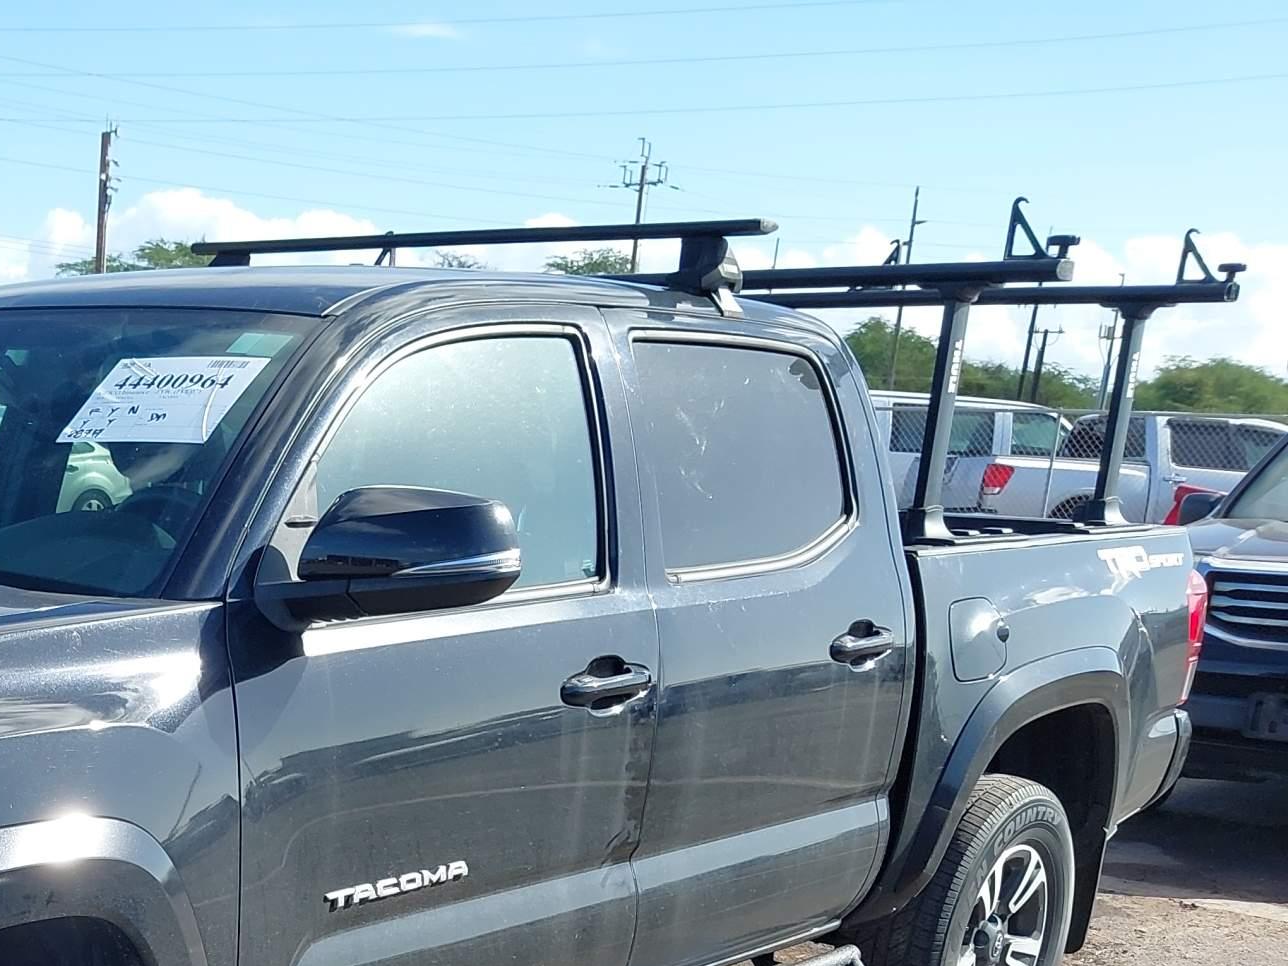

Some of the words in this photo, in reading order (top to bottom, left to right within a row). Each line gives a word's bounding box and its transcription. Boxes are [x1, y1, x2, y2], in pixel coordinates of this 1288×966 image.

[114, 373, 234, 390] 44400964
[993, 806, 1062, 857] COUNTRY
[323, 860, 469, 911] TACOMA
